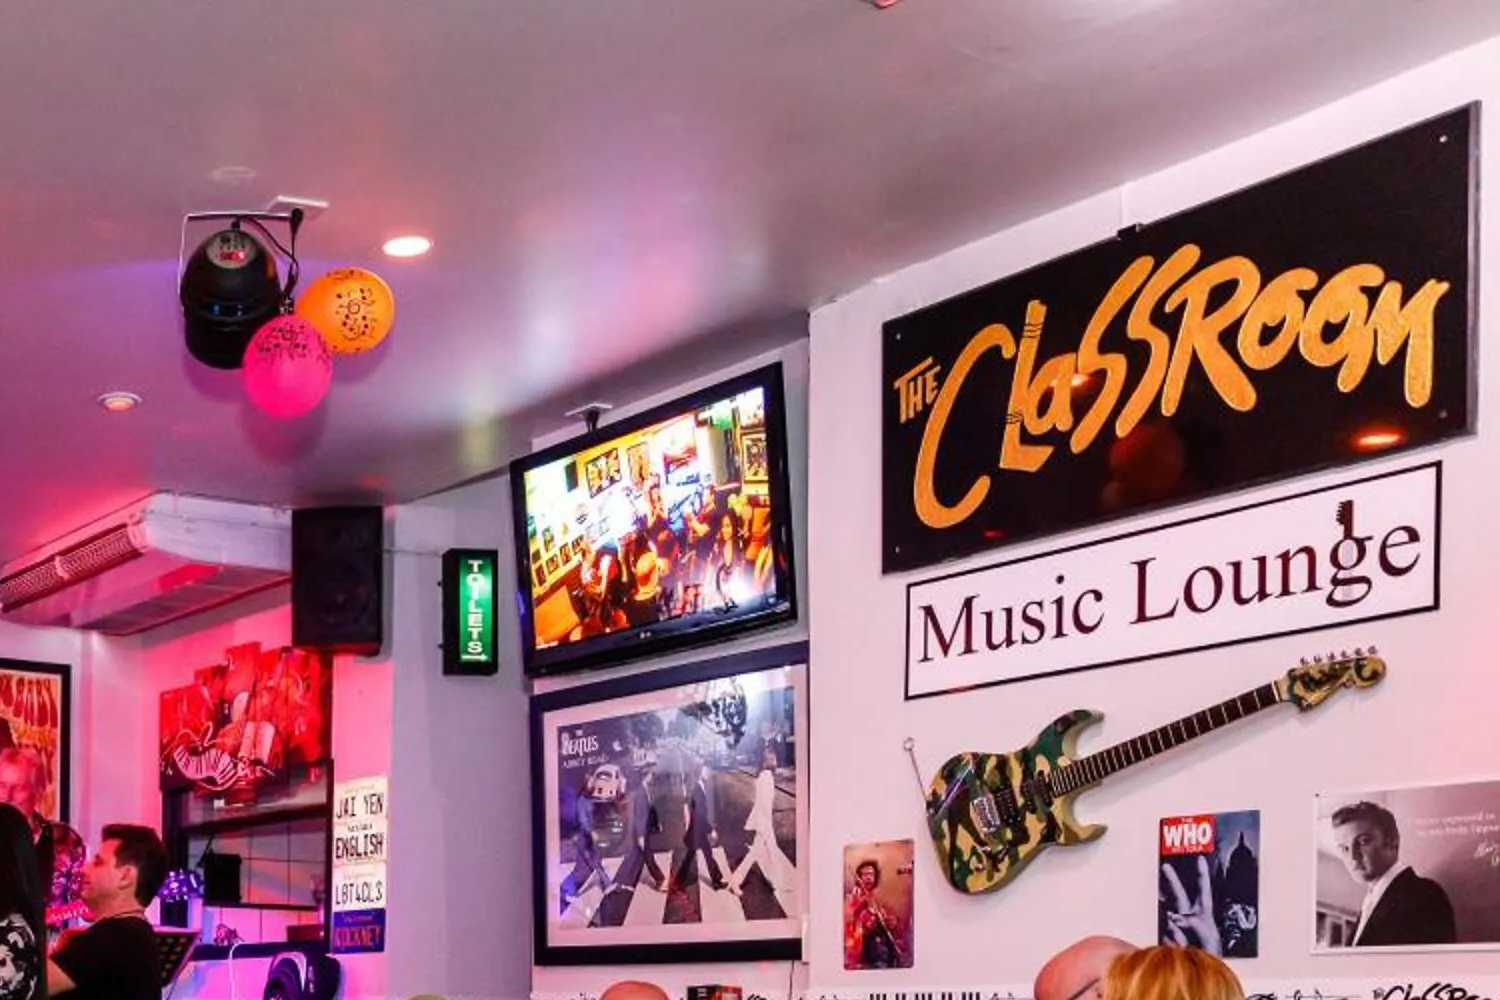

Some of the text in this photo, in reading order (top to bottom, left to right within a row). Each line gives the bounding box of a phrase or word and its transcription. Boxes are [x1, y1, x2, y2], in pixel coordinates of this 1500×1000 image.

[893, 357, 941, 425] THE
[917, 500, 1422, 664] Music Lounge
[466, 559, 486, 654] TOILETS
[336, 793, 384, 819] JAI YEN
[335, 831, 384, 860] ENGLISH
[1163, 822, 1213, 848] WHO
